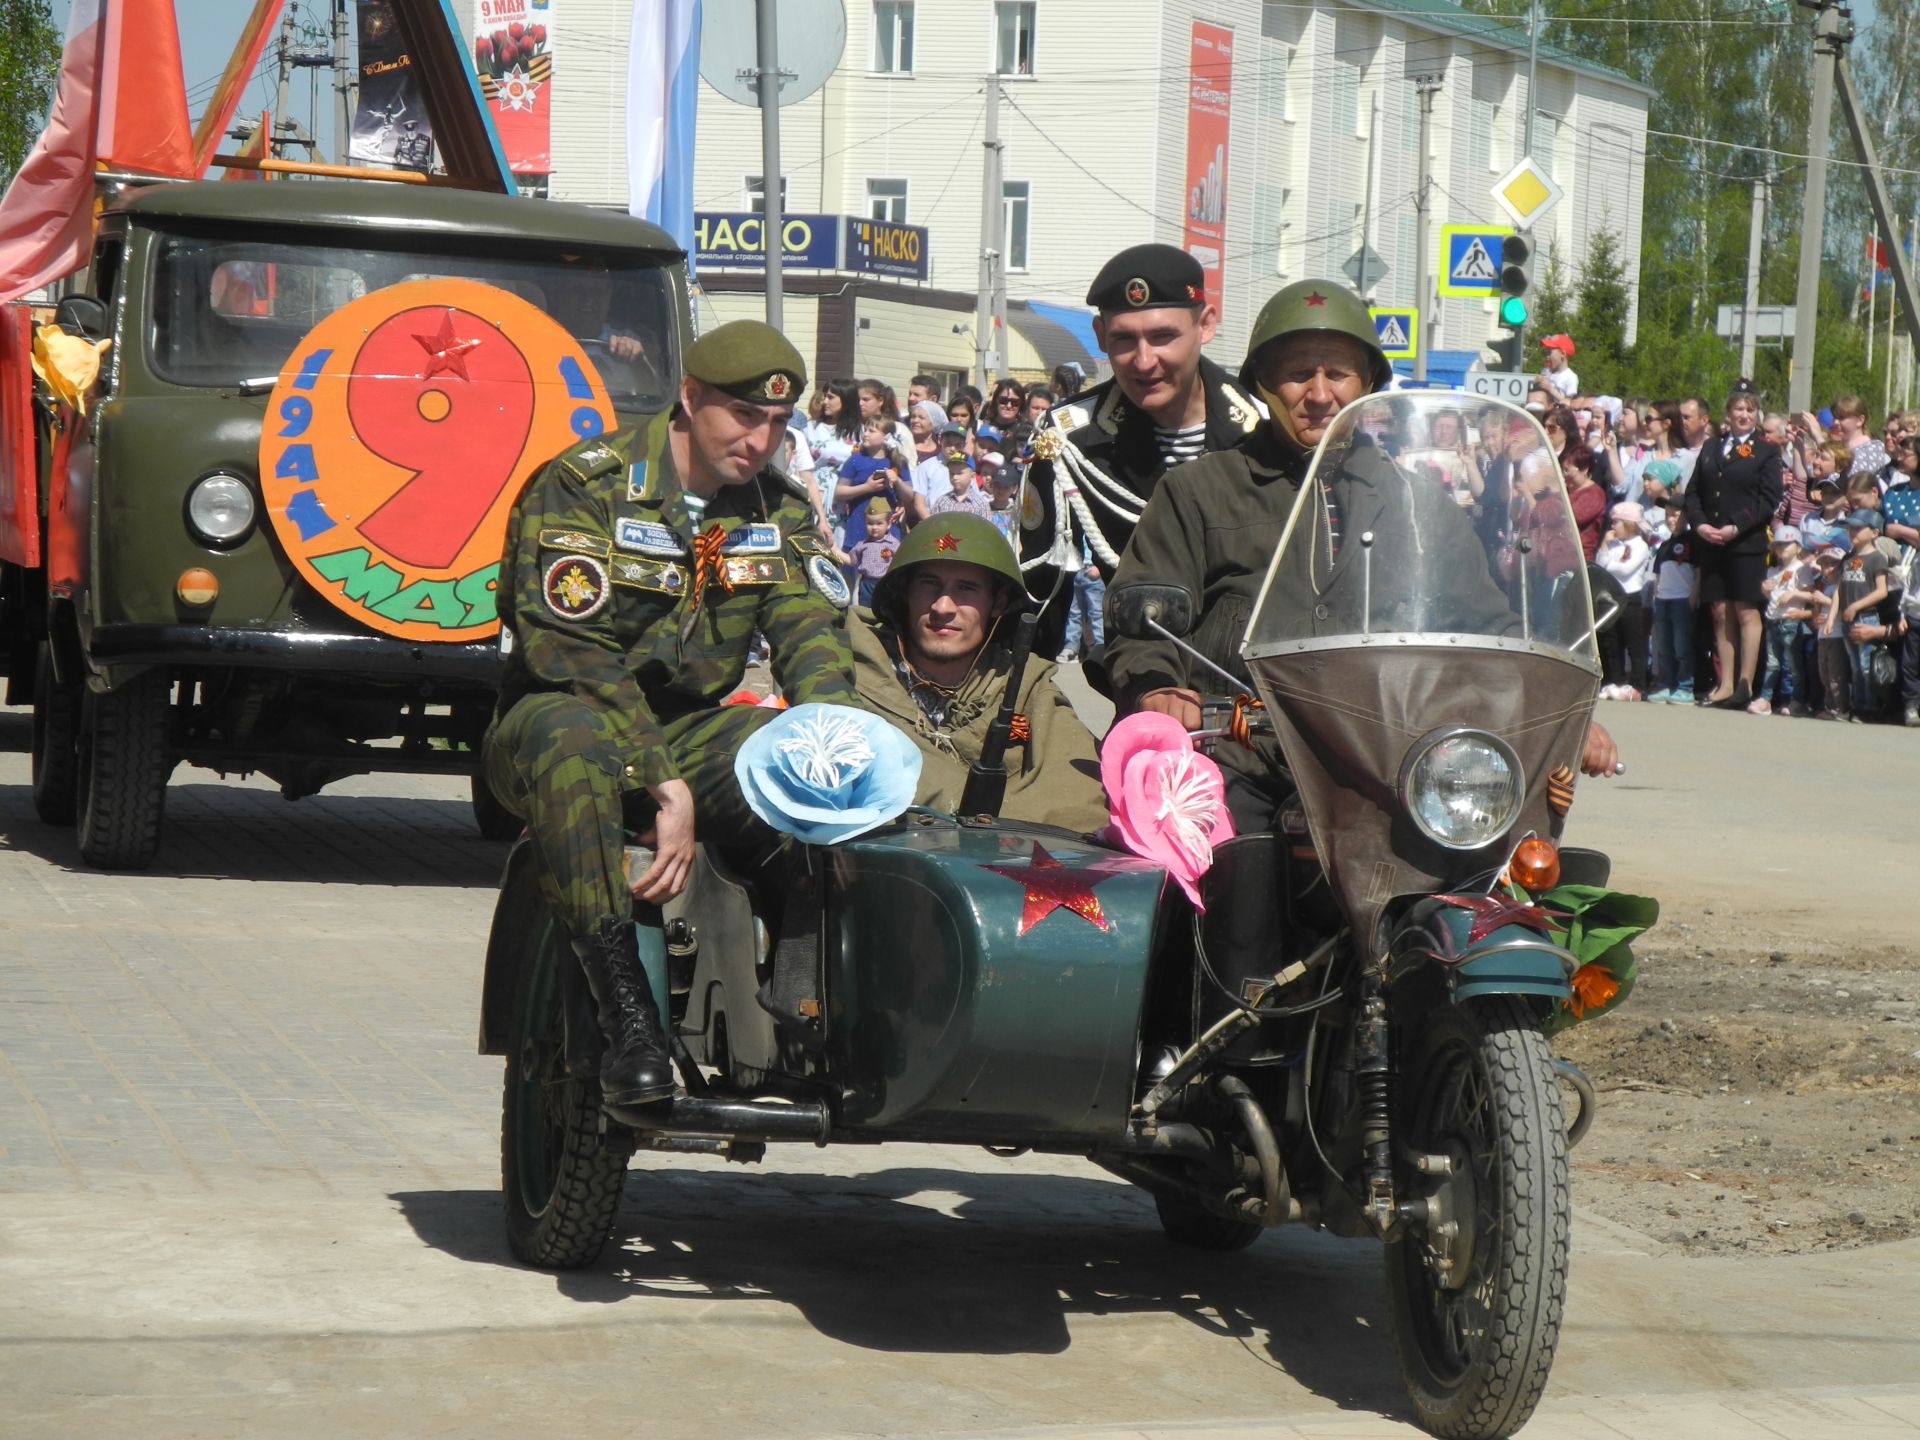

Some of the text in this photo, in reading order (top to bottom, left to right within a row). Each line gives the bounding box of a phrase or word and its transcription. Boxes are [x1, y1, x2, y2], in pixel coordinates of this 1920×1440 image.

[481, 0, 525, 16] 9 МАЯ
[694, 218, 812, 252] НАСО
[873, 226, 919, 262] НАСКО
[557, 355, 604, 441] 19
[275, 348, 338, 542] 1941
[346, 304, 536, 570] 9
[752, 533, 773, 542] Rh+
